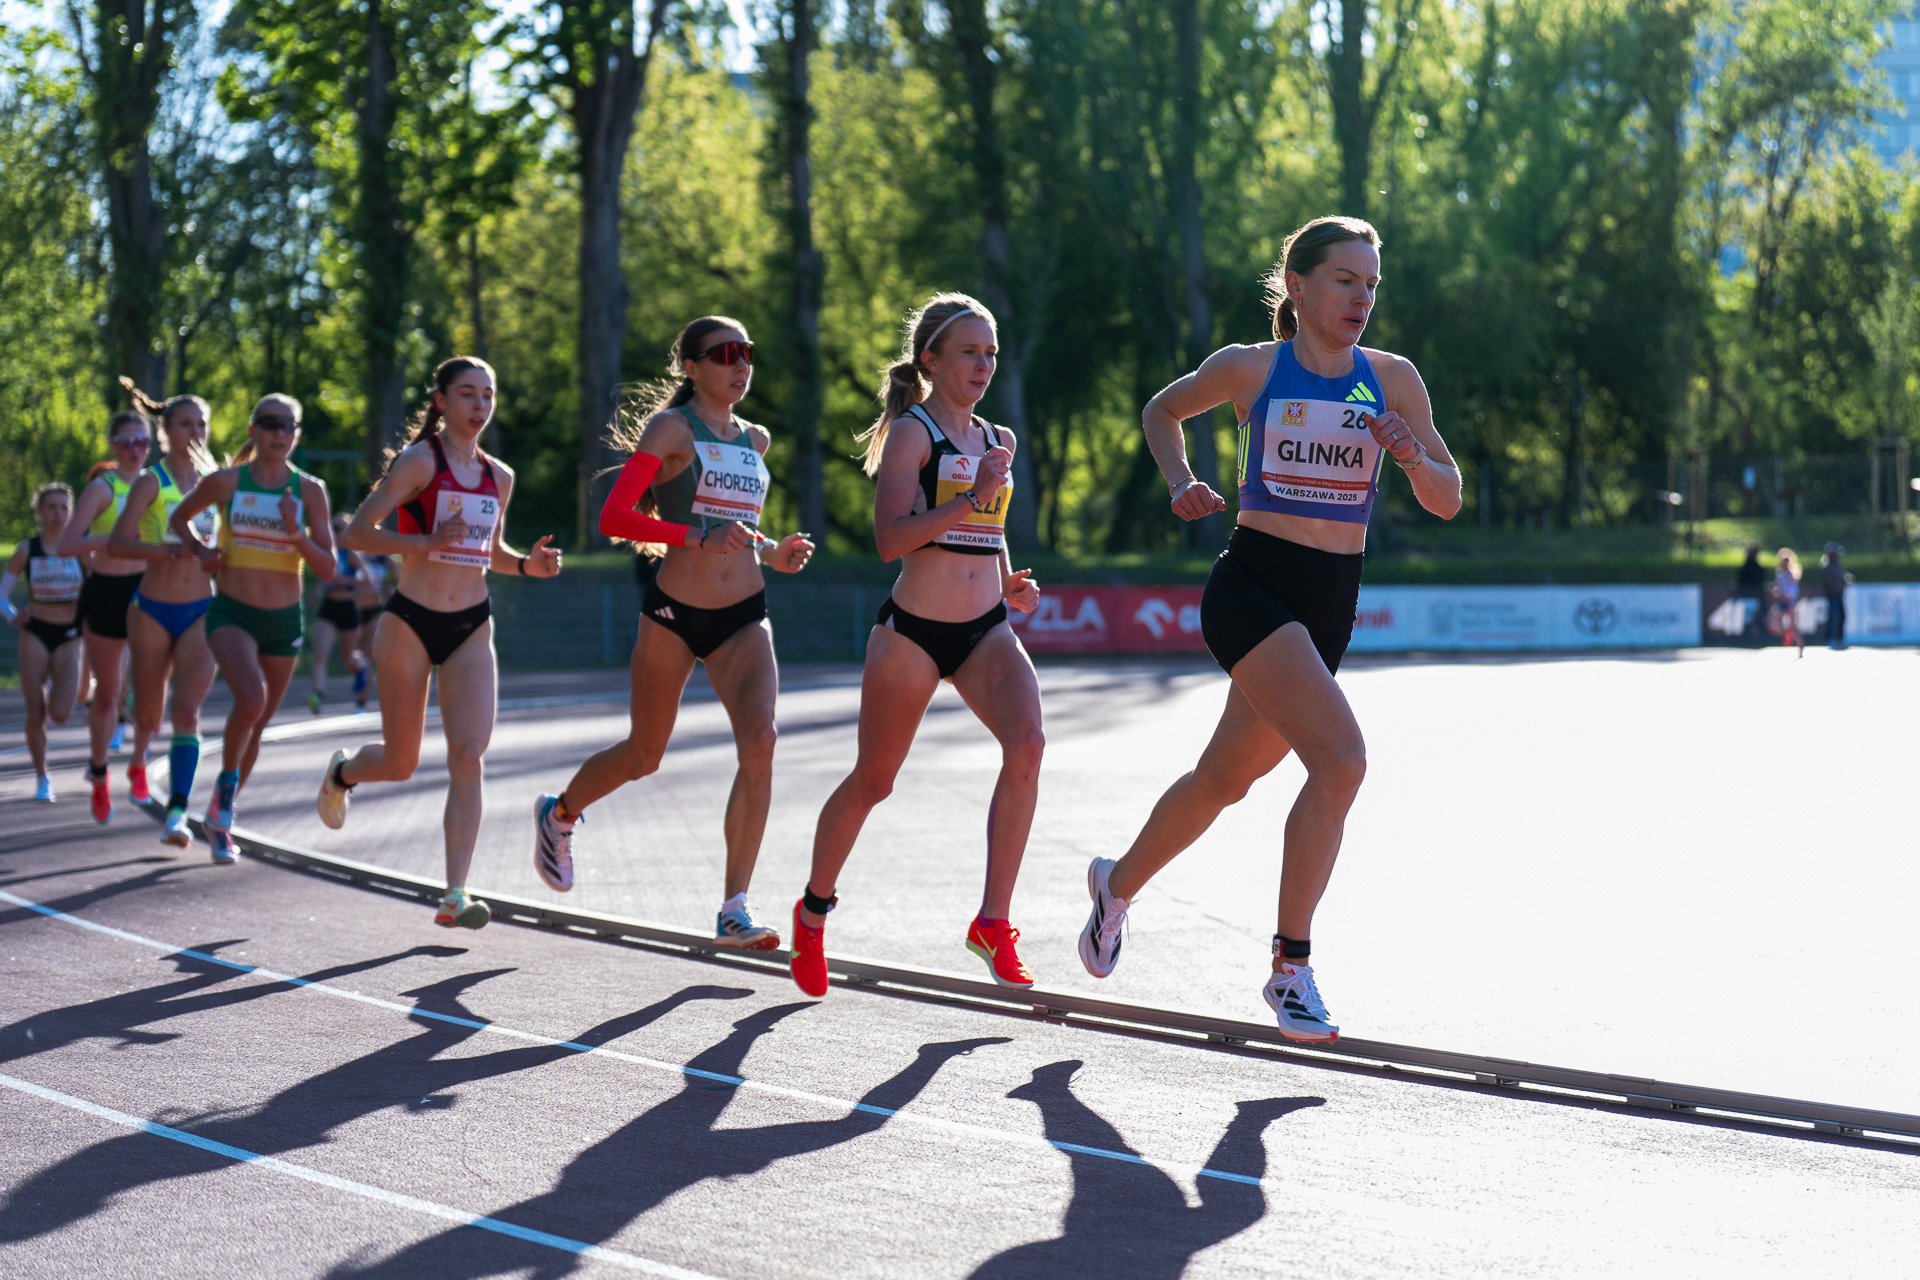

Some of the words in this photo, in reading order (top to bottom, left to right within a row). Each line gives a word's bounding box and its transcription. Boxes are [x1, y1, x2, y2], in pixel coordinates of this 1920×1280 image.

[1341, 409, 1368, 430] 26
[740, 451, 757, 467] 23
[1277, 439, 1364, 469] GLINKA
[704, 470, 765, 498] CHORZĘPA
[951, 473, 972, 481] ORLEN
[1275, 485, 1335, 501] WARSZAWA
[1337, 493, 1358, 502] 2025
[481, 500, 494, 515] 25
[704, 506, 749, 519] WARSZAWA
[946, 533, 990, 544] WARSZAWA
[440, 553, 480, 564] WARSZAWA
[1707, 597, 1759, 636] 4F
